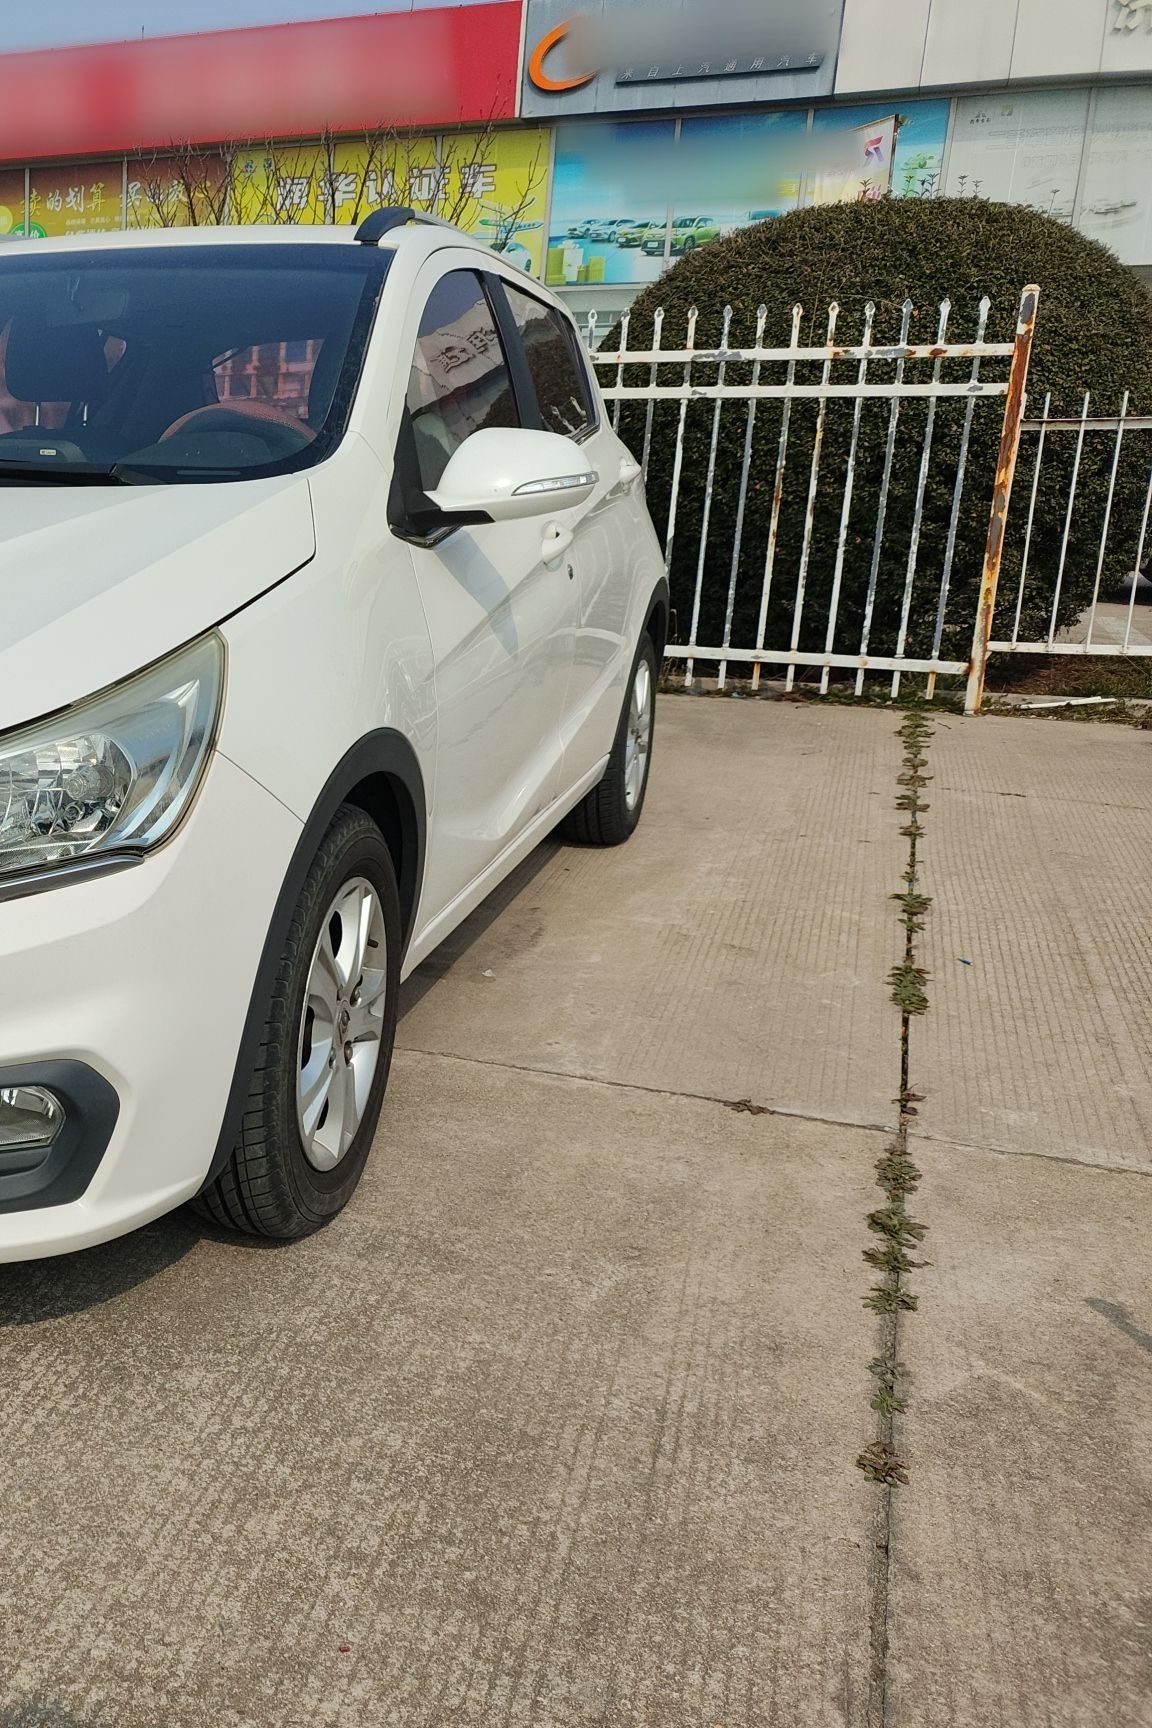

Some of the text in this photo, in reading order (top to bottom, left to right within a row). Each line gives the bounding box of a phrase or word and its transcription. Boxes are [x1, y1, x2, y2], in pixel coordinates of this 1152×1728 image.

[621, 51, 822, 80] 来自上汽通用汽车
[19, 182, 106, 217] 卖的划算
[275, 162, 497, 211] 润华认证车
